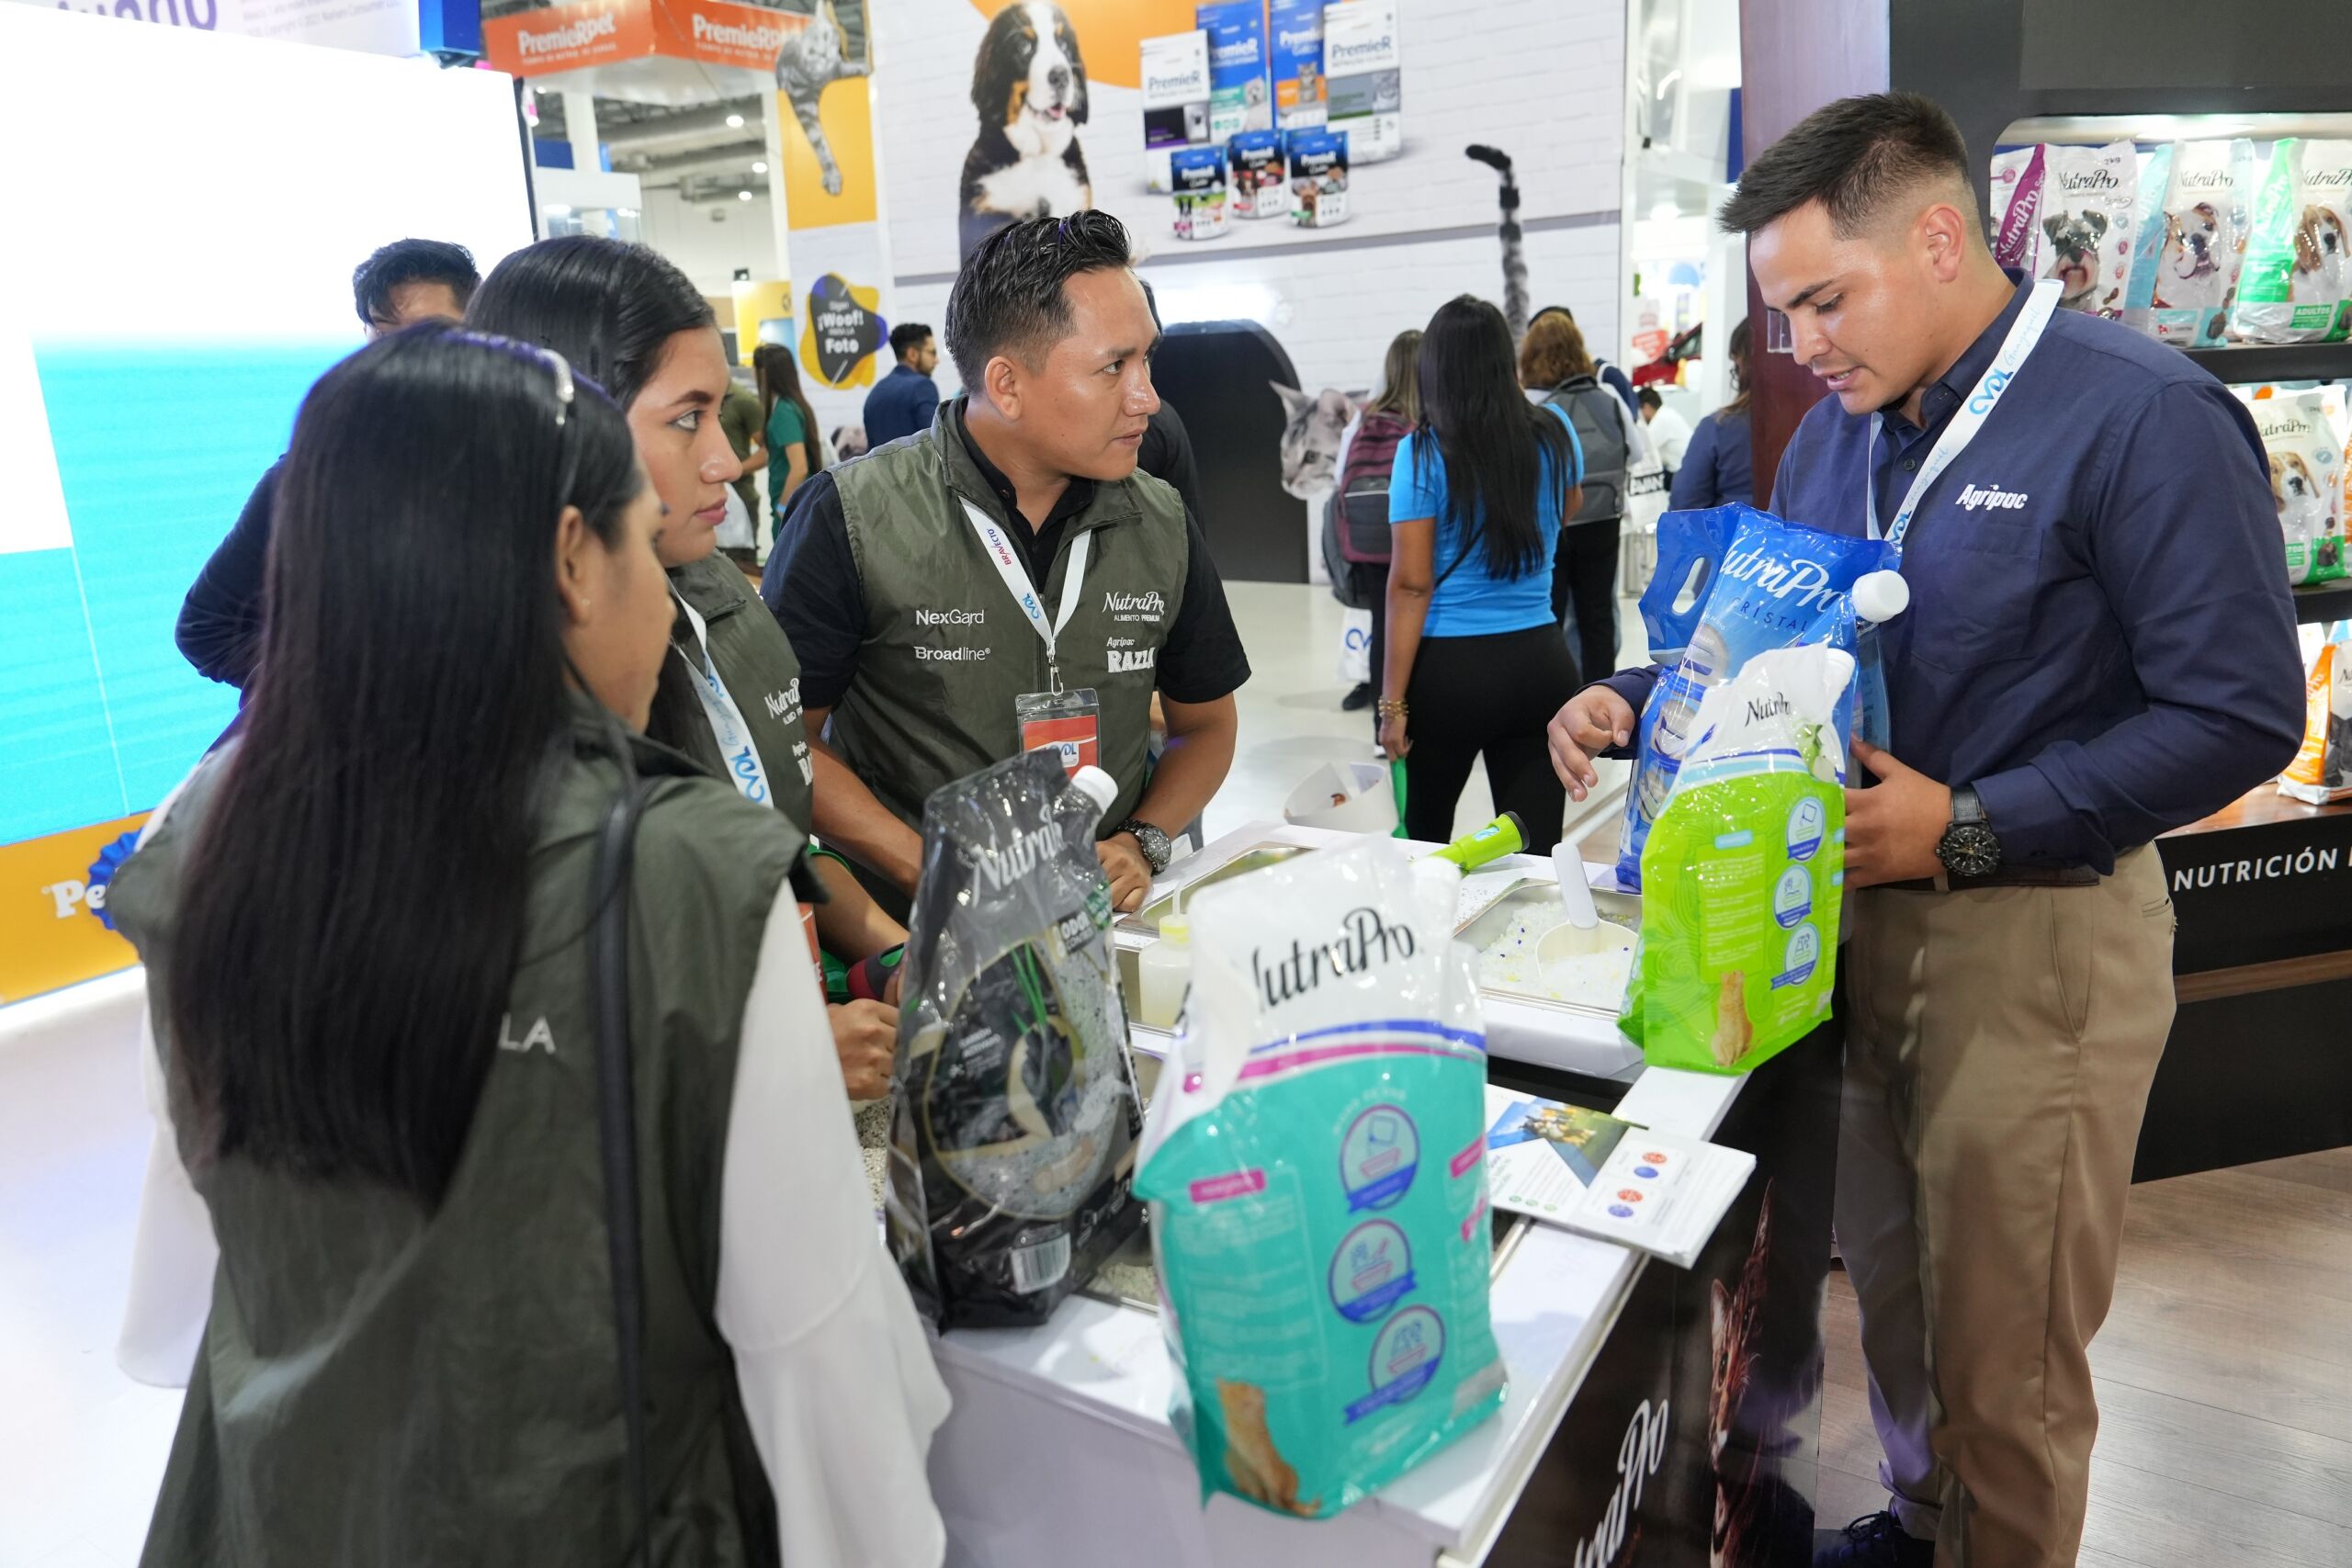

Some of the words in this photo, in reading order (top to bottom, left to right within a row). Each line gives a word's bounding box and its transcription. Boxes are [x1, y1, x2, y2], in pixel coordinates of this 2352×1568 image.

[2059, 168, 2119, 191] NutraPro
[2180, 169, 2234, 188] NutraPro
[825, 337, 860, 355] Foto
[1954, 483, 2029, 512] Agripac
[915, 608, 985, 626] NexGard
[1732, 596, 1807, 633] CRISTAL
[1106, 636, 1136, 649] Agripac
[2174, 846, 2337, 892] NUTRICIÓN
